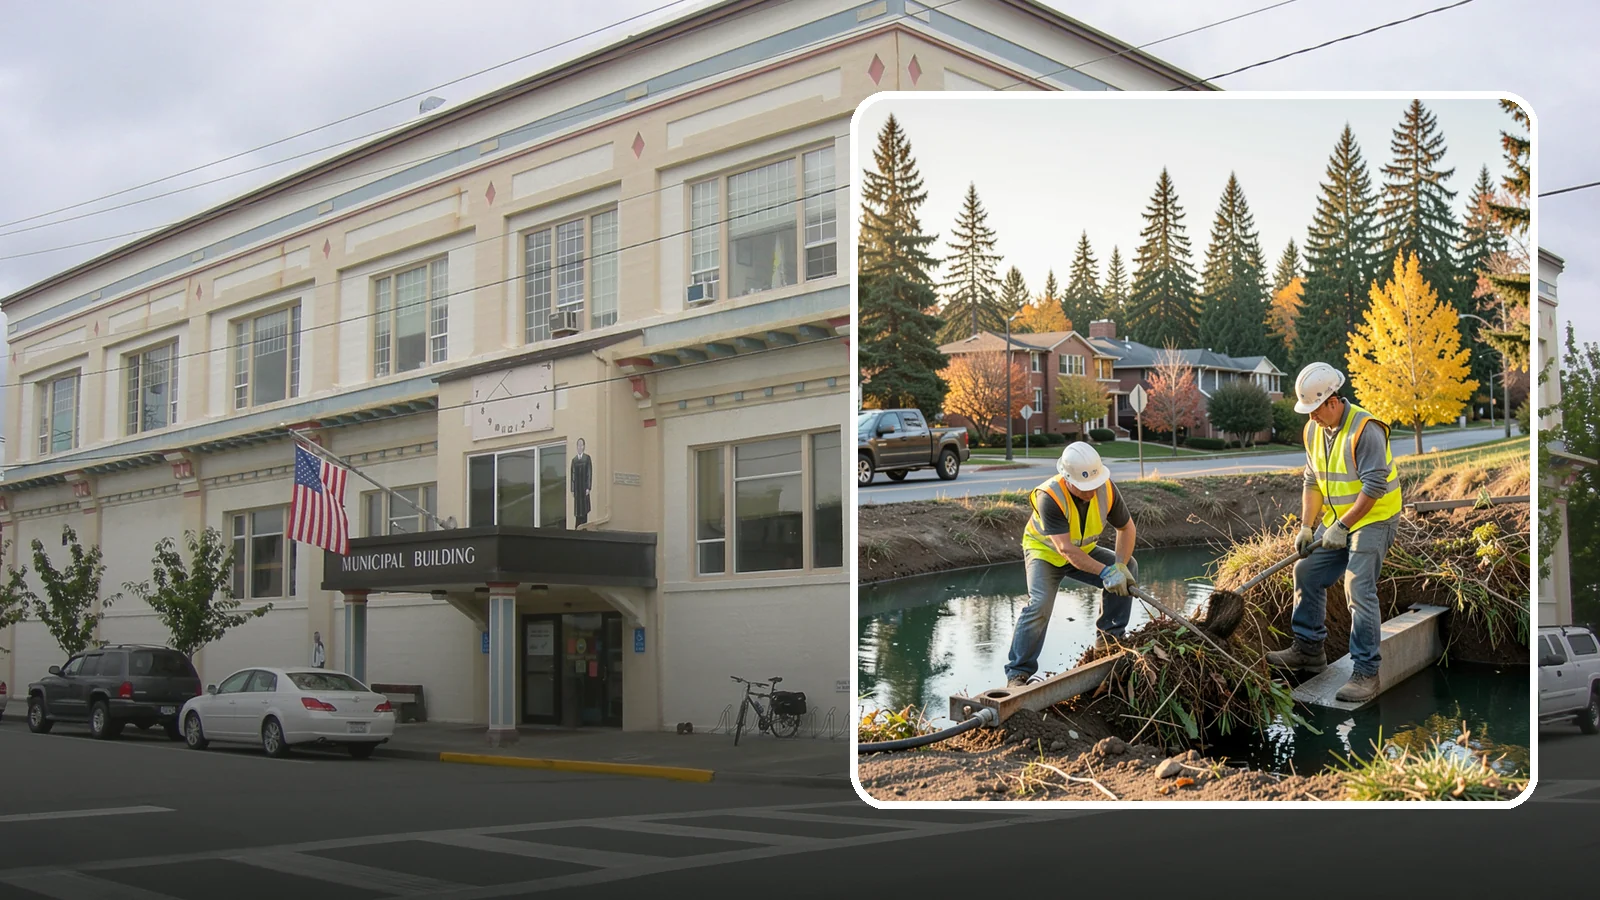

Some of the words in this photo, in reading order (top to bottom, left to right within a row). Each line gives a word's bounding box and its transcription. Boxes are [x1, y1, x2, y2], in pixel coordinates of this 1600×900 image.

[487, 418, 492, 426] 9
[528, 414, 533, 422] 3
[521, 420, 525, 428] 2
[507, 425, 513, 433] 12
[342, 552, 405, 572] MUNICIPAL
[414, 546, 475, 567] BUILDING
